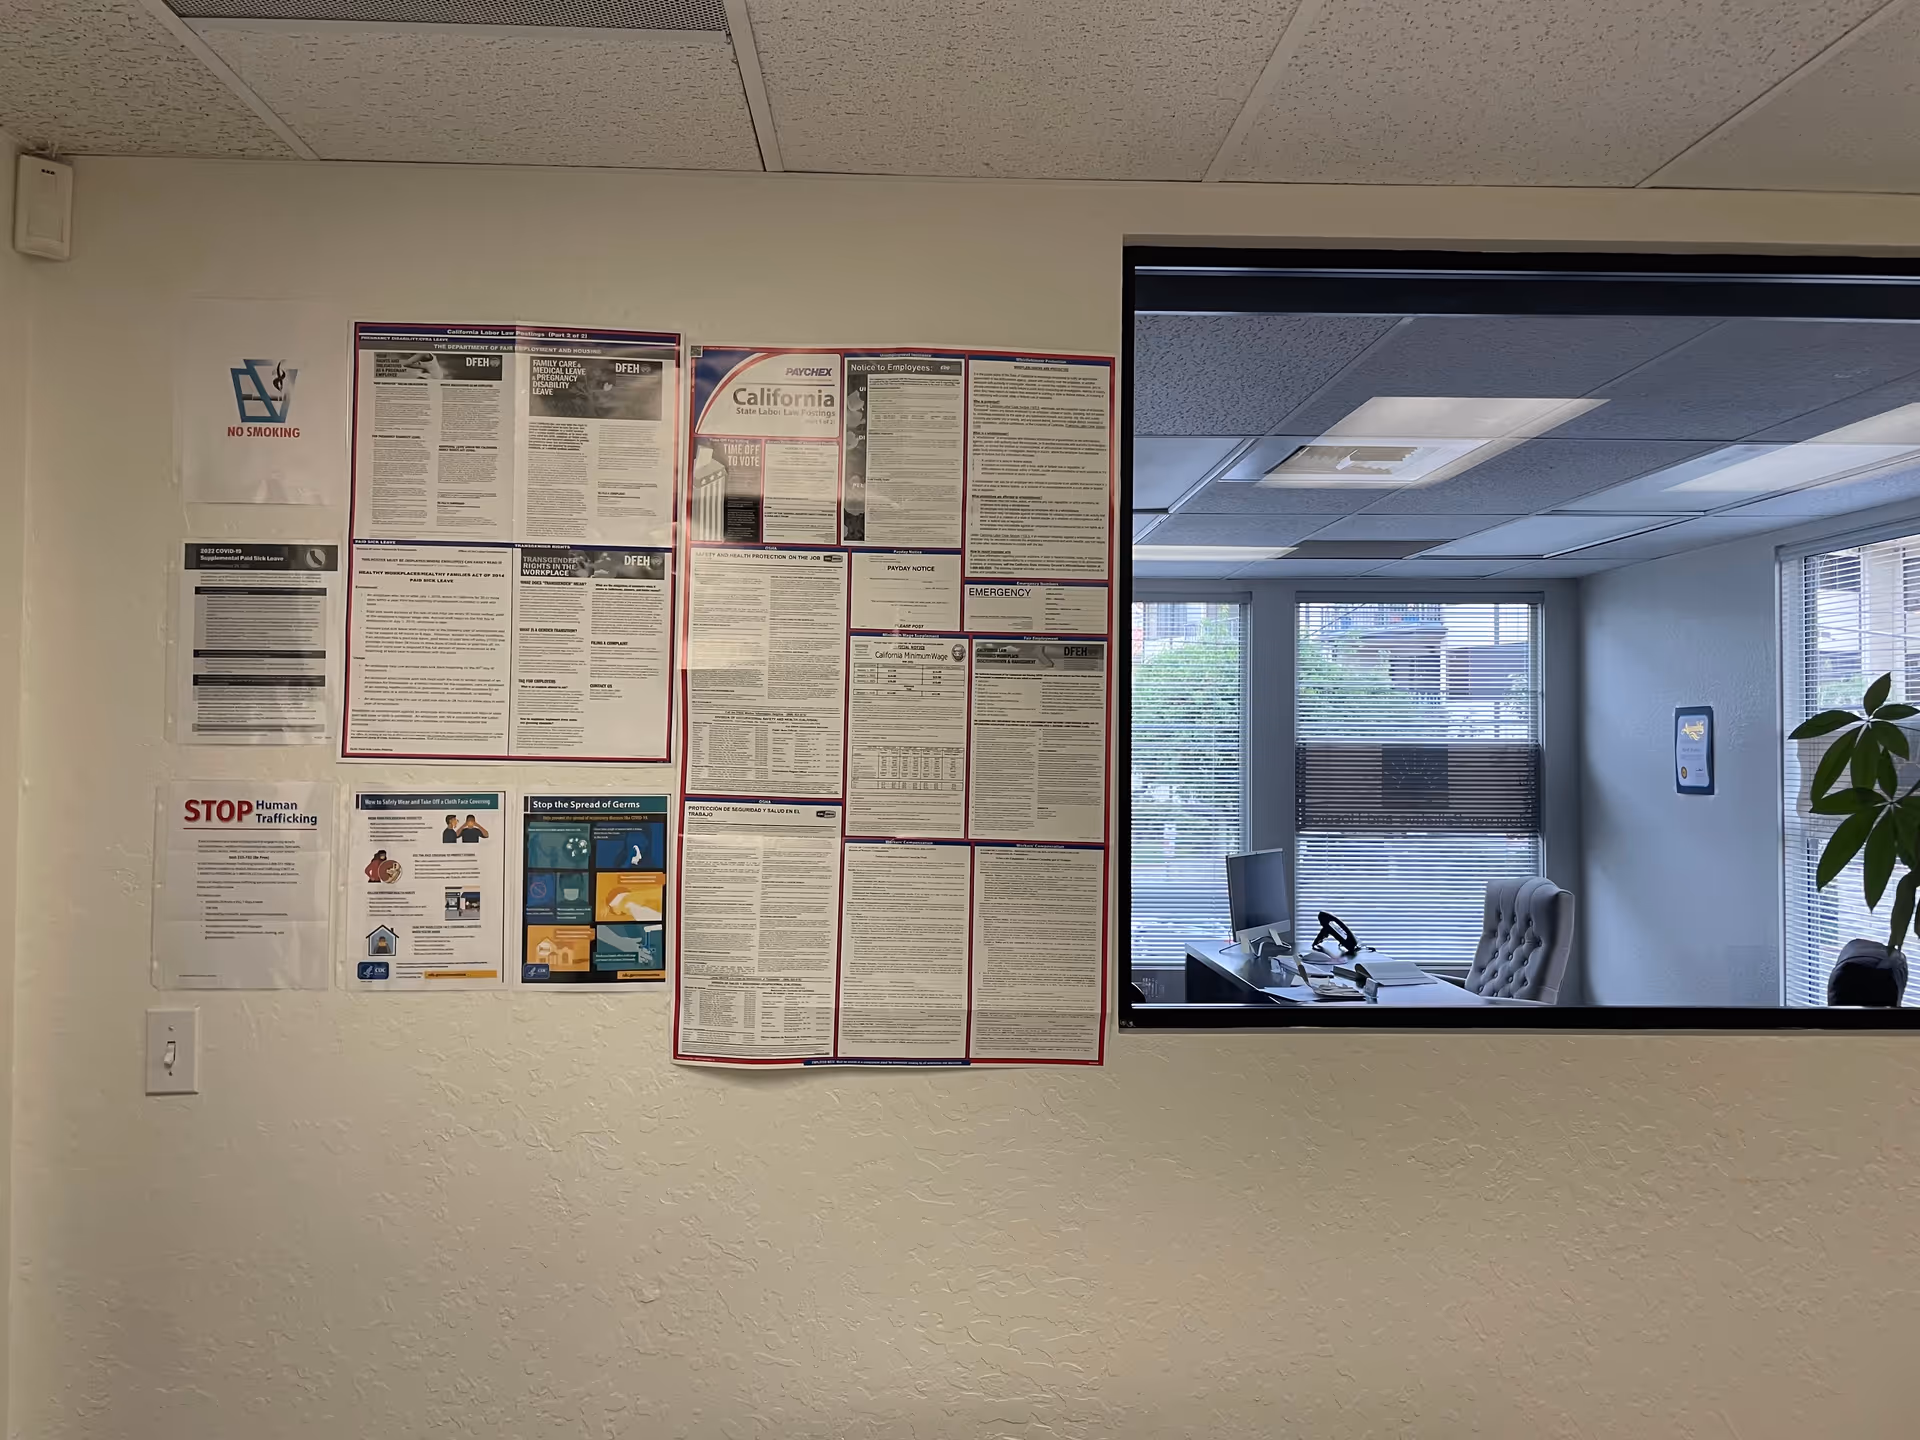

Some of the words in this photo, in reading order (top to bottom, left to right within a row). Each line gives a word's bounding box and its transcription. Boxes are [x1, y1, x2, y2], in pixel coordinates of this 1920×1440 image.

[466, 357, 490, 366] DFEH
[558, 360, 577, 368] CARE
[532, 366, 564, 374] MEDICAL
[616, 362, 640, 374] DFEH
[785, 368, 832, 376] PAYCHEX
[851, 364, 876, 372] Notice
[887, 364, 933, 372] Employees:
[536, 374, 578, 382] PREGNANCY
[532, 381, 570, 389] DISABILITY
[532, 388, 554, 396] LEAVE
[732, 388, 835, 408] California
[758, 408, 781, 416] Labor
[784, 408, 800, 416] Law
[801, 410, 836, 418] Postings
[227, 426, 244, 436] NO
[246, 426, 300, 438] SMOKING
[724, 444, 743, 454] TIME
[744, 444, 760, 456] OFF
[728, 456, 738, 466] TO
[740, 456, 760, 467] VOTE
[523, 556, 578, 564] TRANSGENDER
[624, 556, 650, 566] DFEH
[968, 588, 1032, 597] EMERGENCY
[875, 651, 903, 659] California
[931, 652, 948, 661] Wage
[1064, 646, 1088, 656] DFEH
[533, 800, 553, 810] Stop
[554, 800, 568, 808] the
[570, 801, 600, 810] Spread
[612, 801, 640, 809] Germs
[184, 799, 253, 823] STOP
[256, 800, 298, 810] Human
[256, 813, 318, 825] Trafficking
